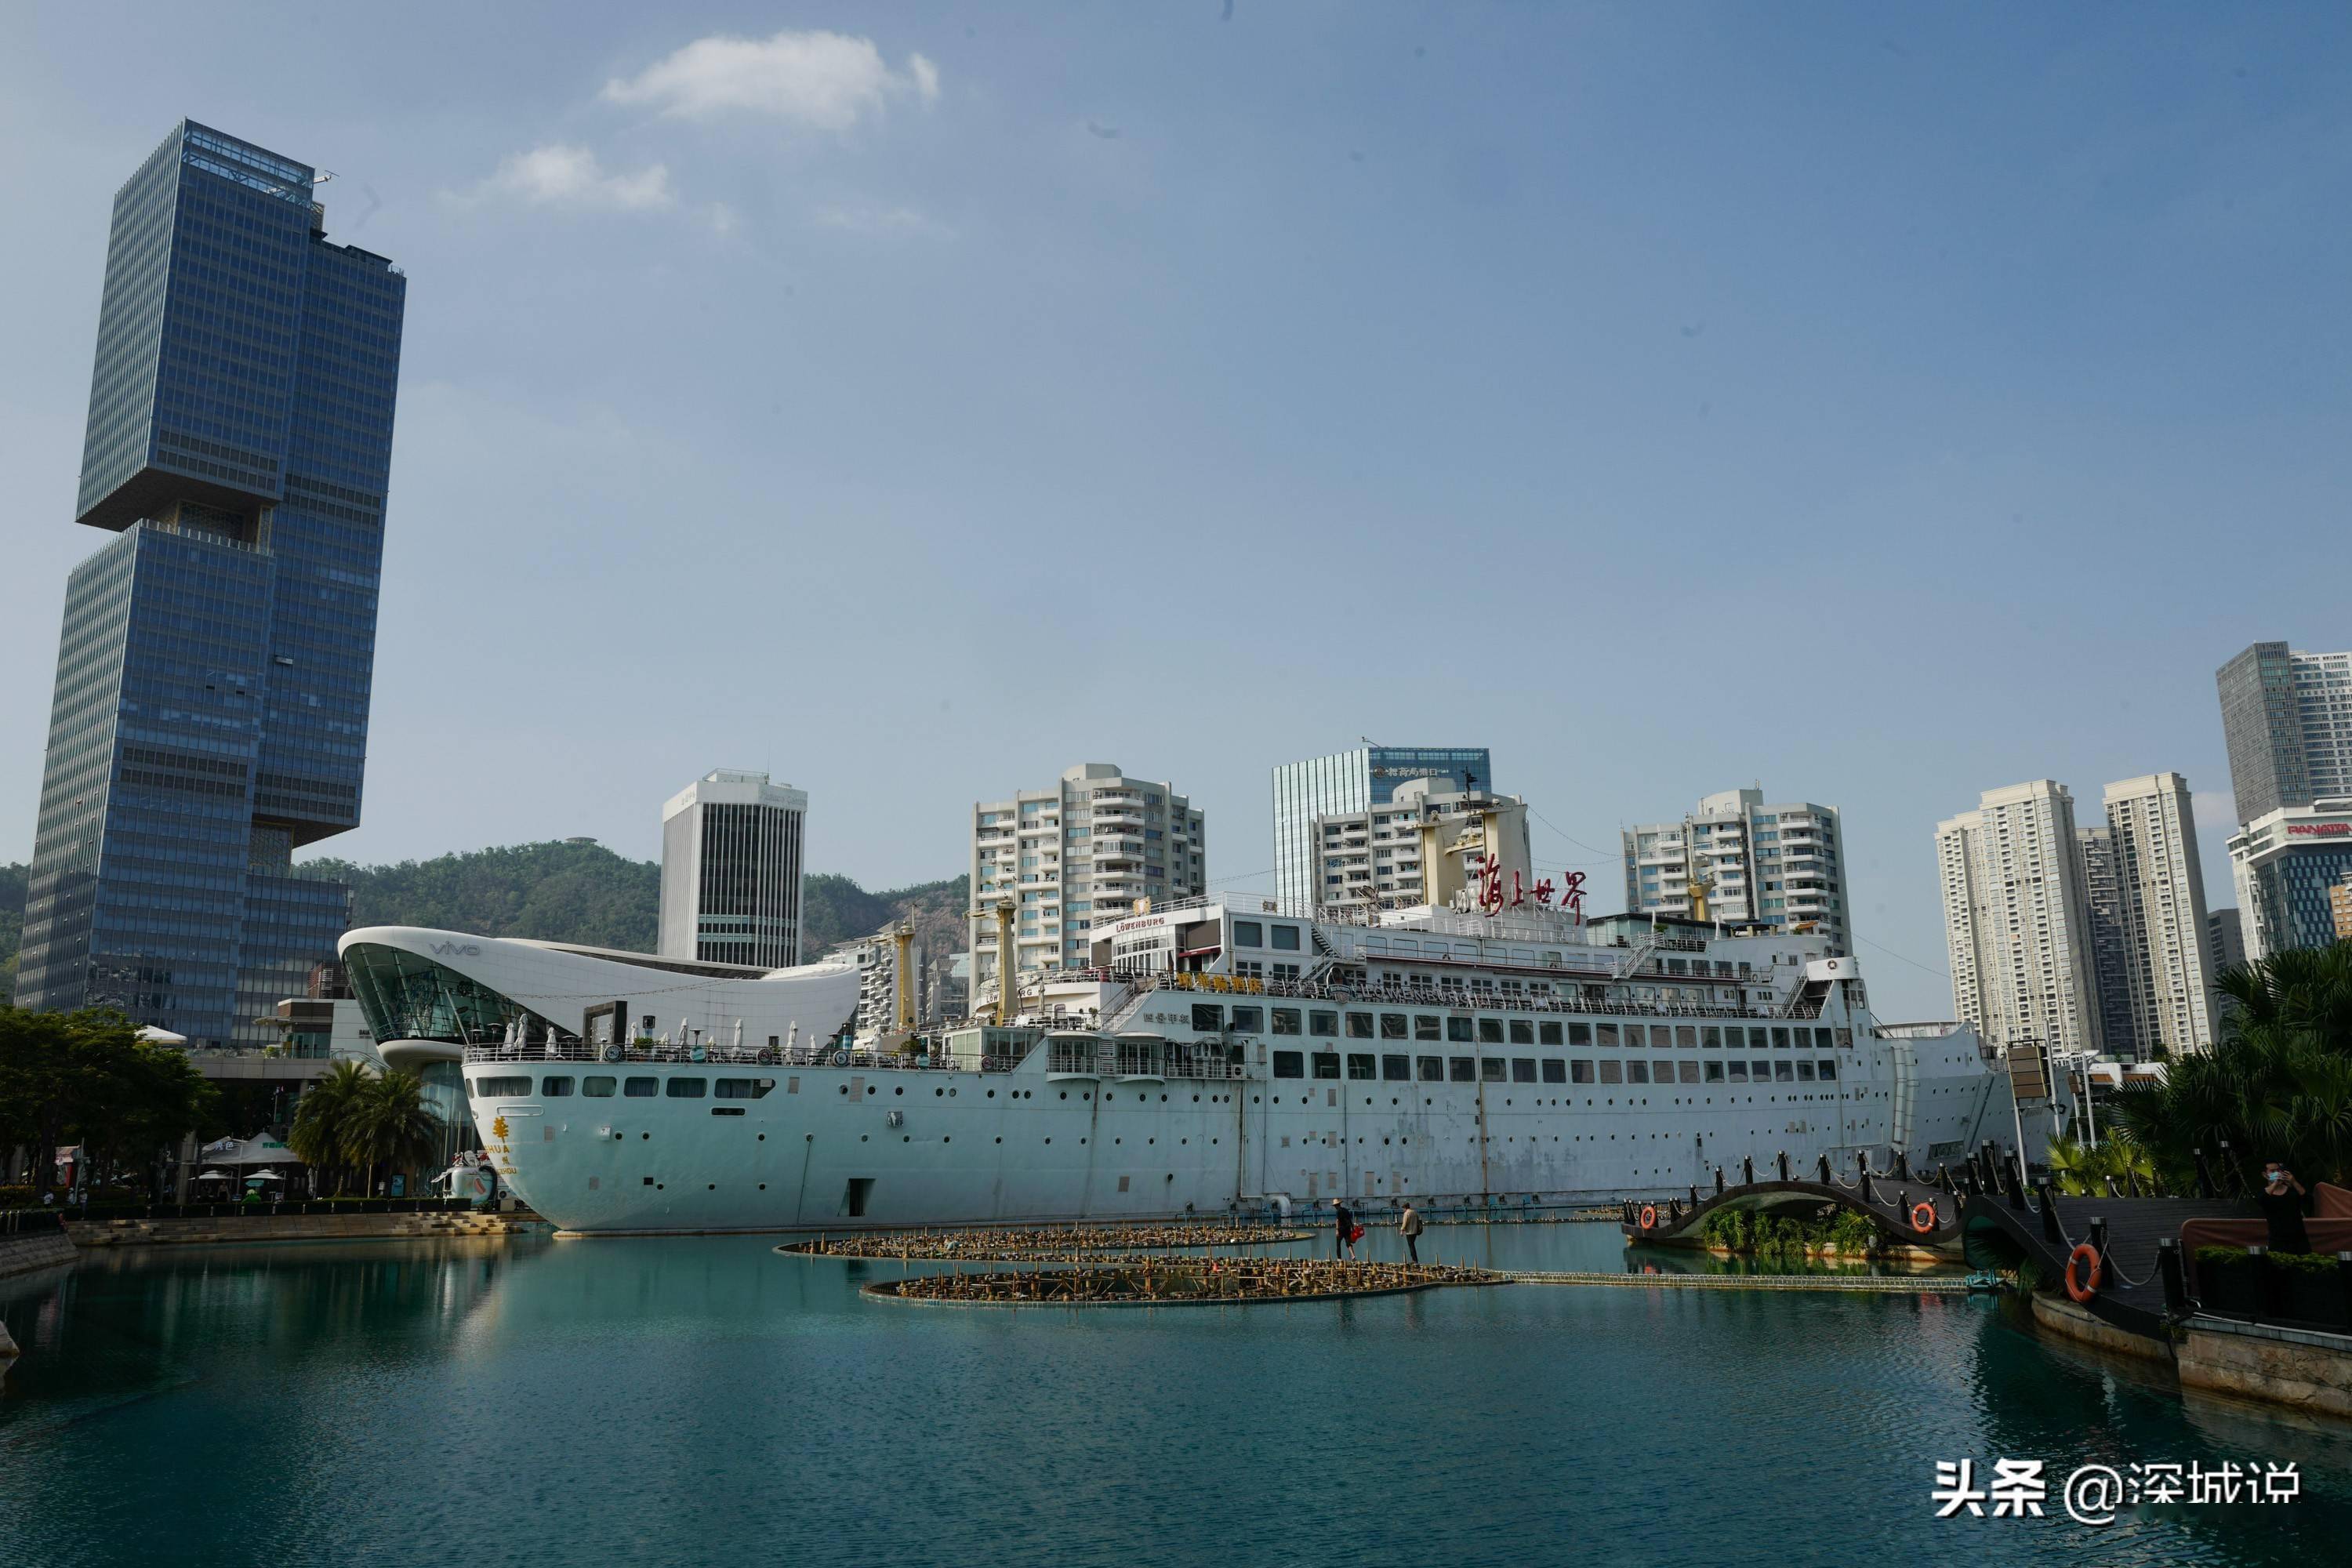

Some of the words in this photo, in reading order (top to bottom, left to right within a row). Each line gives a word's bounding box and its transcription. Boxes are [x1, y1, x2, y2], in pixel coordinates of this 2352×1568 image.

[1475, 853, 1588, 926] 海上世界
[429, 940, 481, 956] vivo
